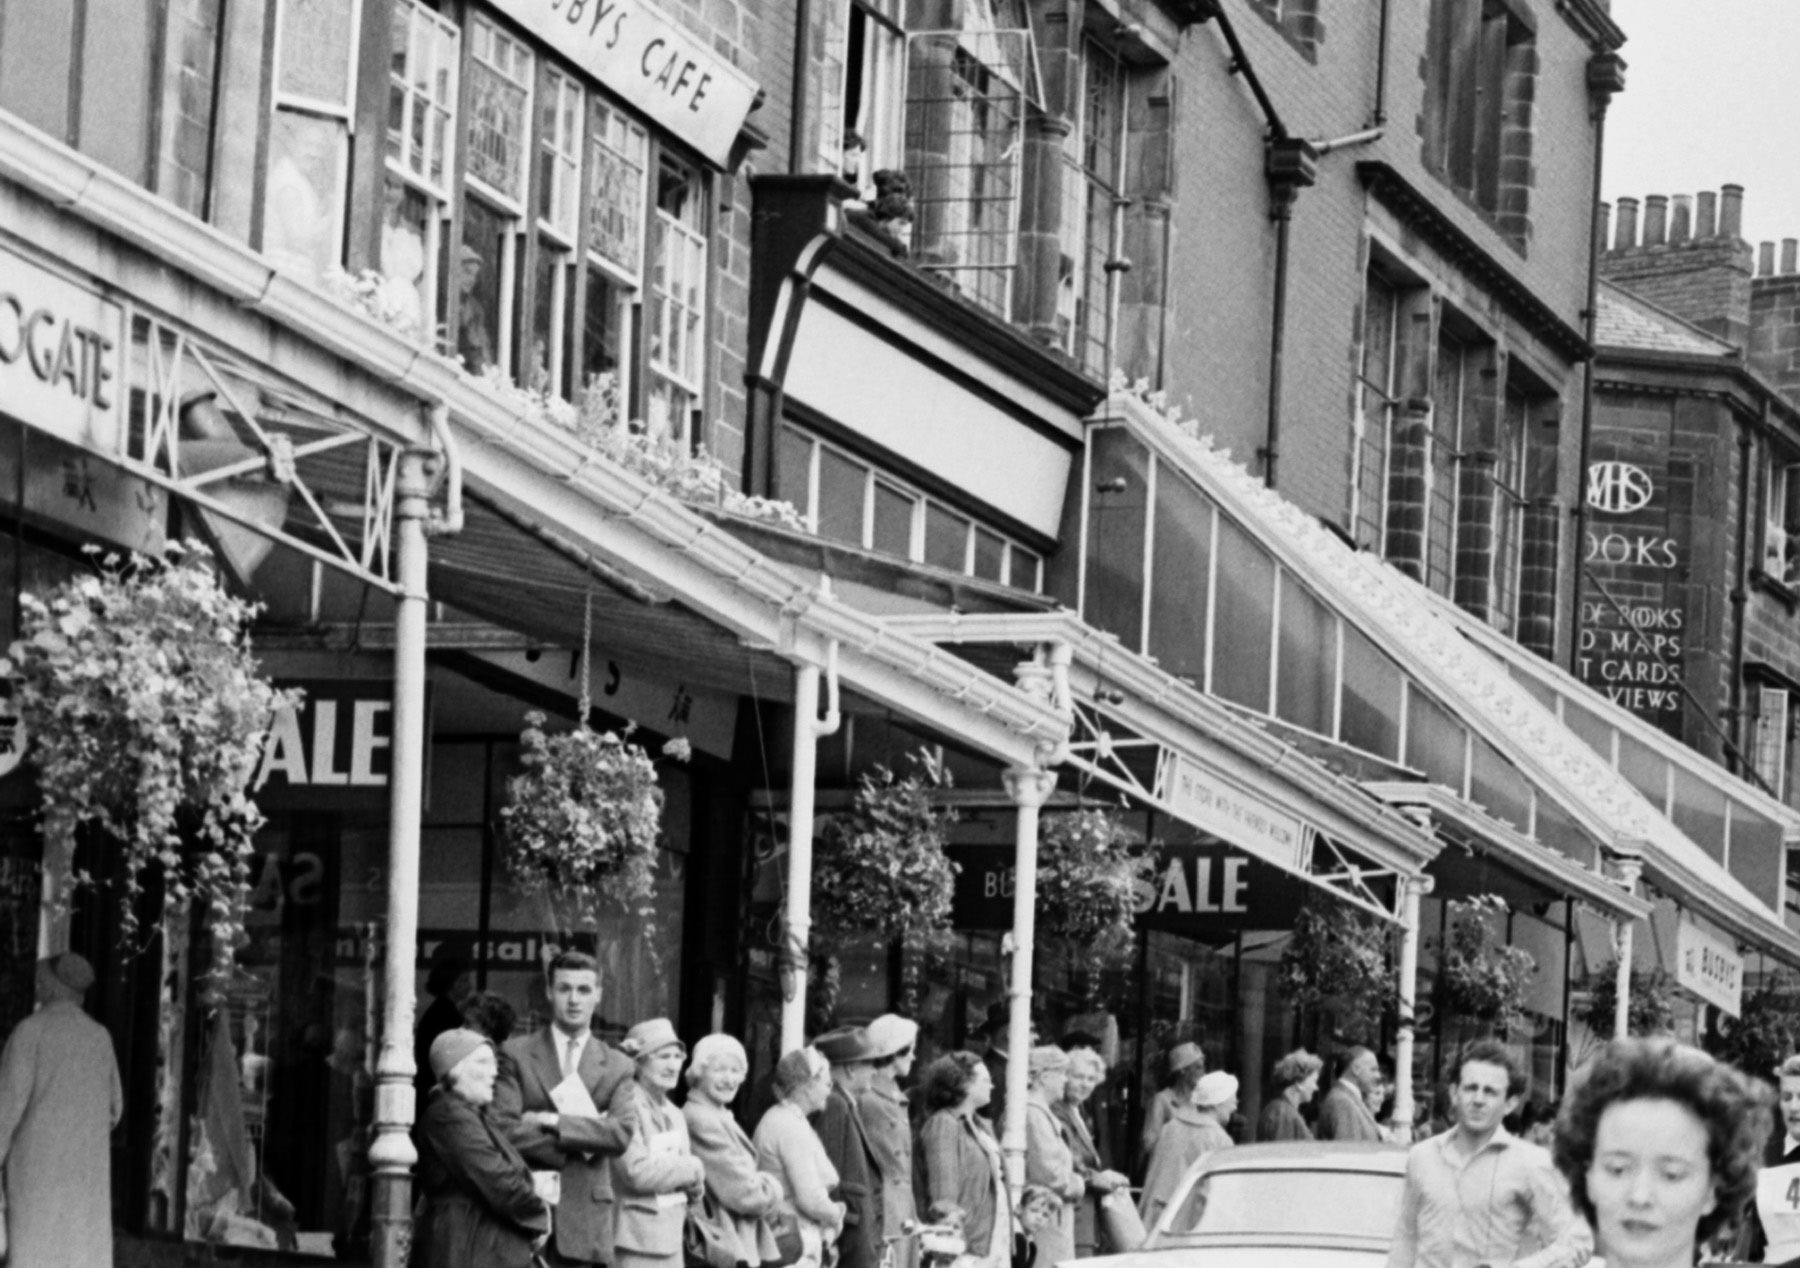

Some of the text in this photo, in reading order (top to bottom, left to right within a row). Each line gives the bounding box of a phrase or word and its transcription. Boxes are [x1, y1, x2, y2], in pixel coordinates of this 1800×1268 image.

[552, 0, 712, 112] BYS CAFE
[1610, 631, 1681, 657] MAPS
[1600, 659, 1681, 685] CARDS
[1606, 686, 1678, 712] VIEWS
[254, 699, 392, 788] ALE
